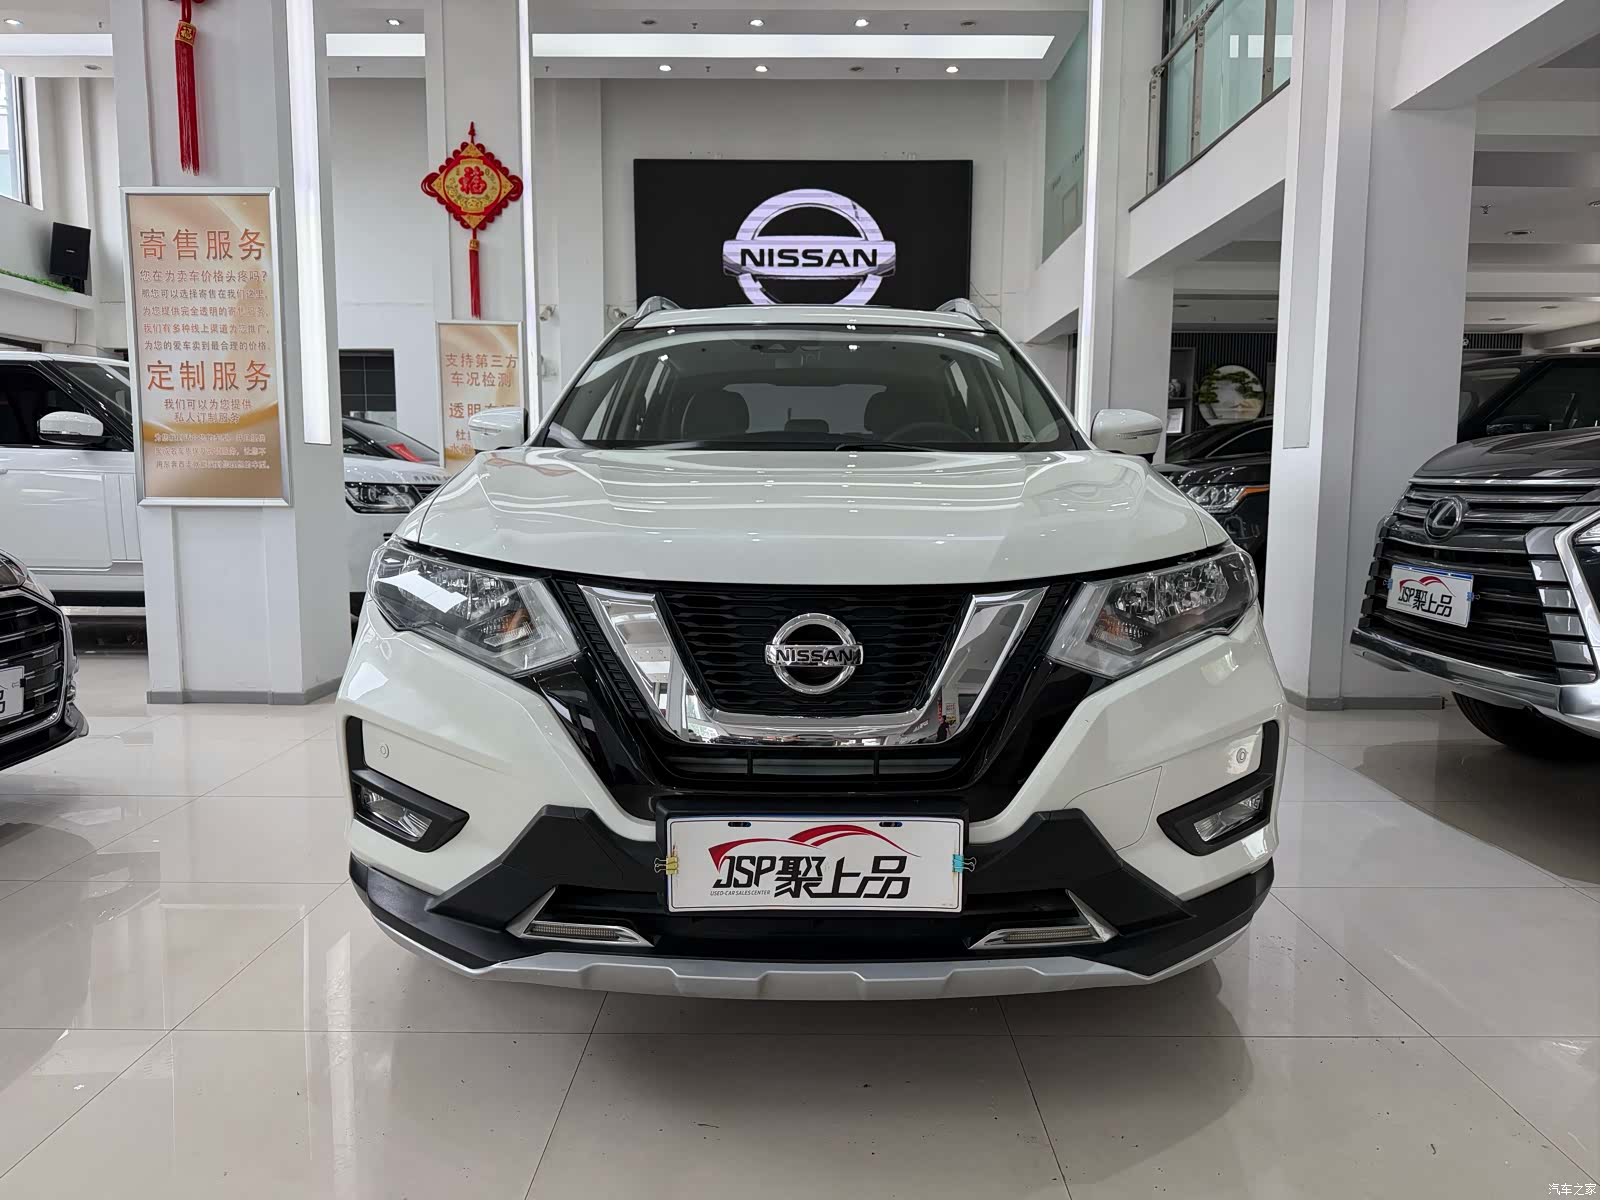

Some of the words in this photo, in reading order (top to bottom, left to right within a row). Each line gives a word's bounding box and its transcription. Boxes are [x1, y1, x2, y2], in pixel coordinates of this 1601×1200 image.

[459, 166, 487, 195] 福
[139, 228, 265, 260] 寄售服务
[740, 248, 878, 267] NISSAN
[445, 353, 518, 369] 支持第三方
[147, 360, 271, 391] 定制服务
[450, 371, 512, 388] 车况检测
[164, 398, 252, 410] 我们可以为您提供
[174, 412, 240, 424] 私人订制服务
[776, 648, 853, 662] NISSAN
